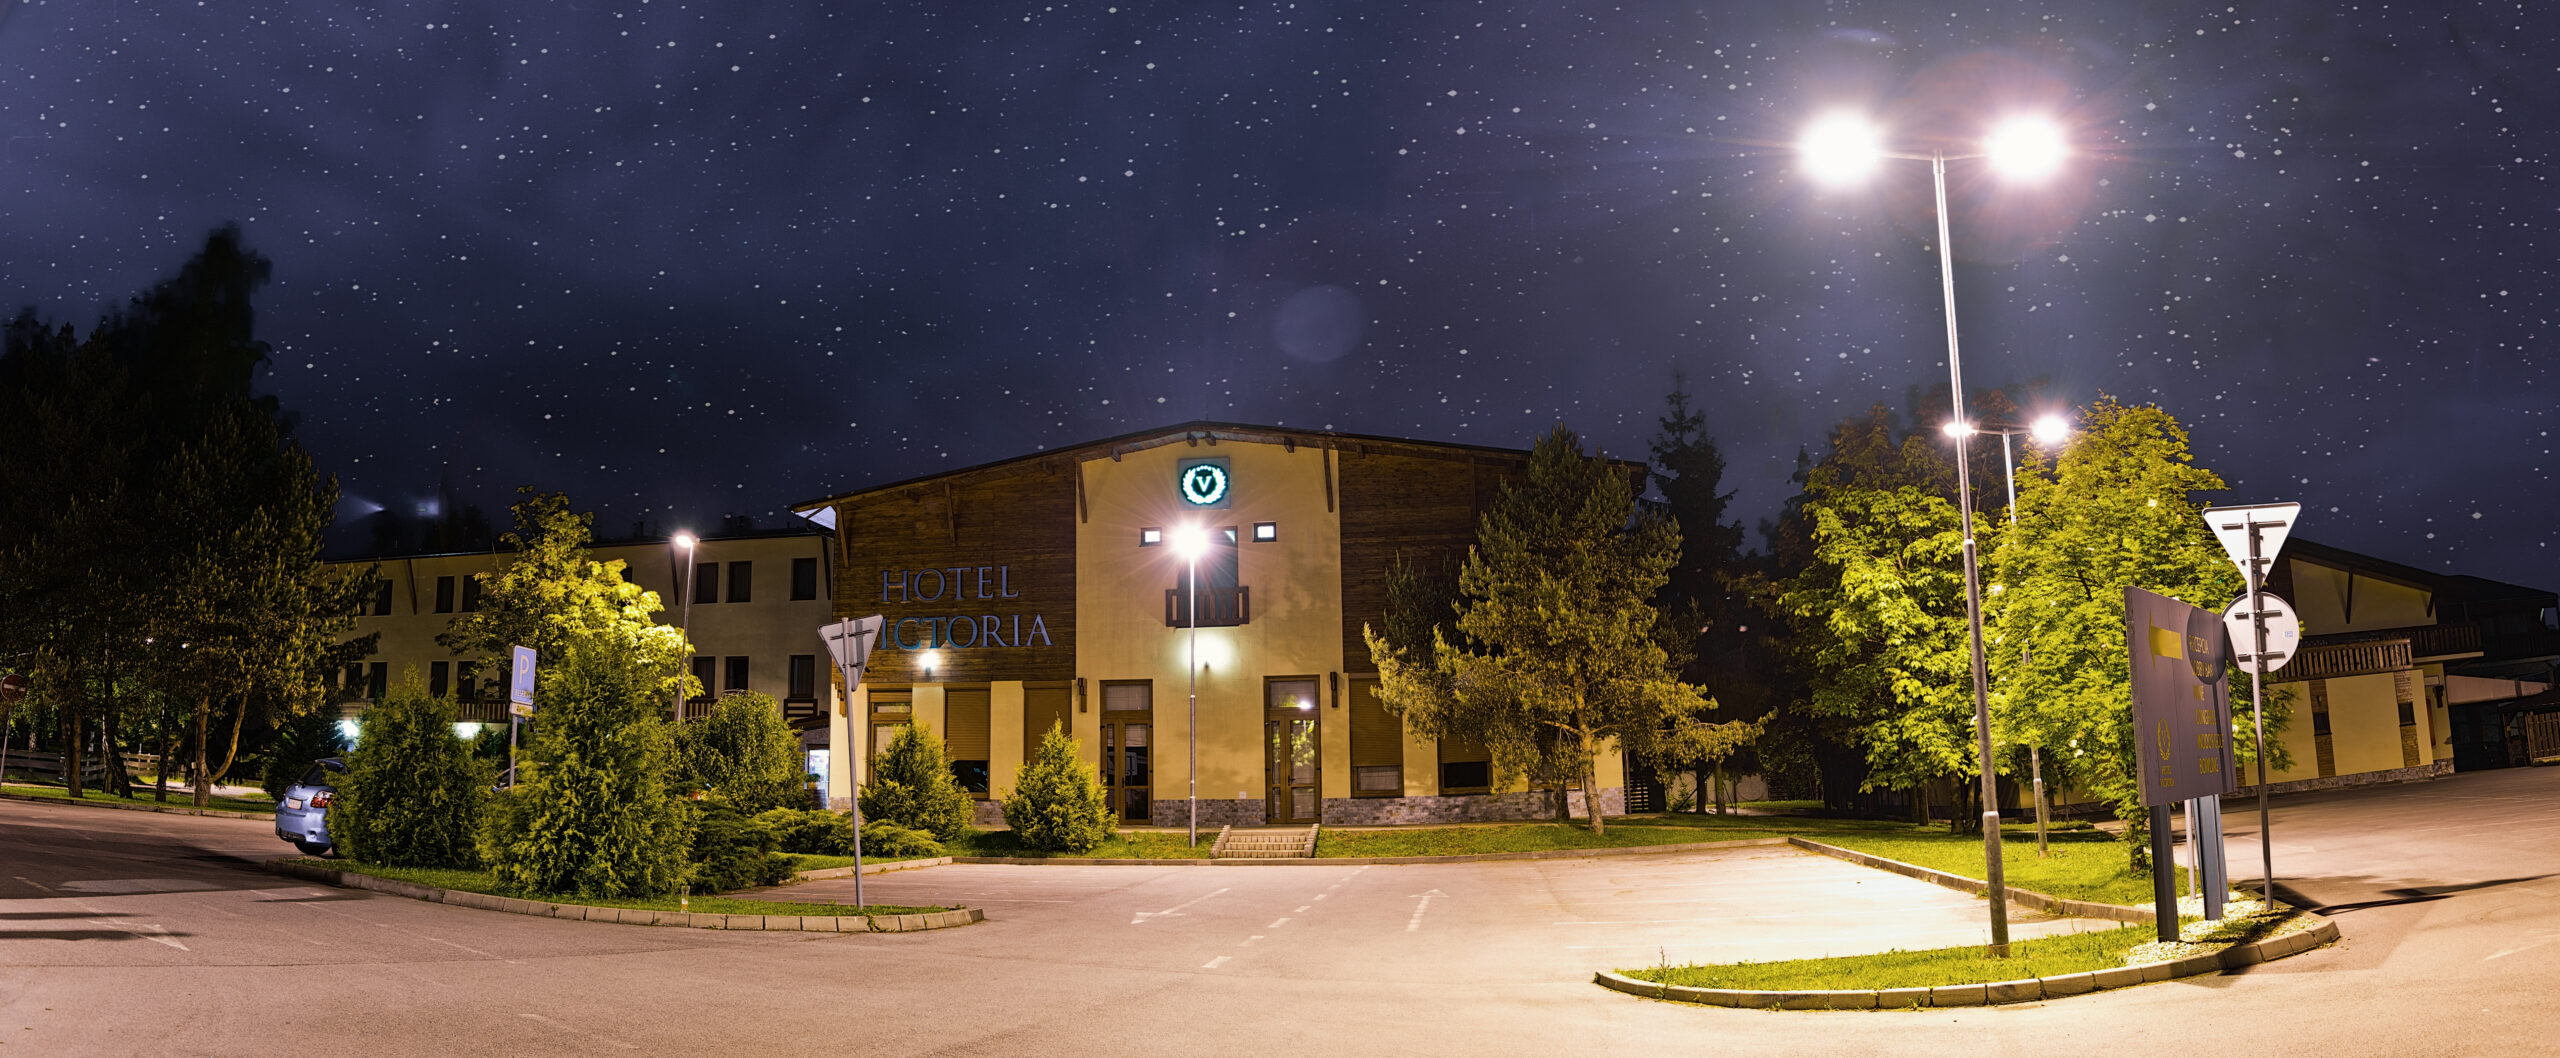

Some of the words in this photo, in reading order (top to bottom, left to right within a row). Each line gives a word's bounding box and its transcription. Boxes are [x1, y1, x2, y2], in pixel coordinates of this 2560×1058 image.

[1196, 476, 1212, 493] V
[881, 565, 1020, 602] HOTEL
[880, 613, 1053, 650] ICTORIA
[519, 655, 530, 684] P
